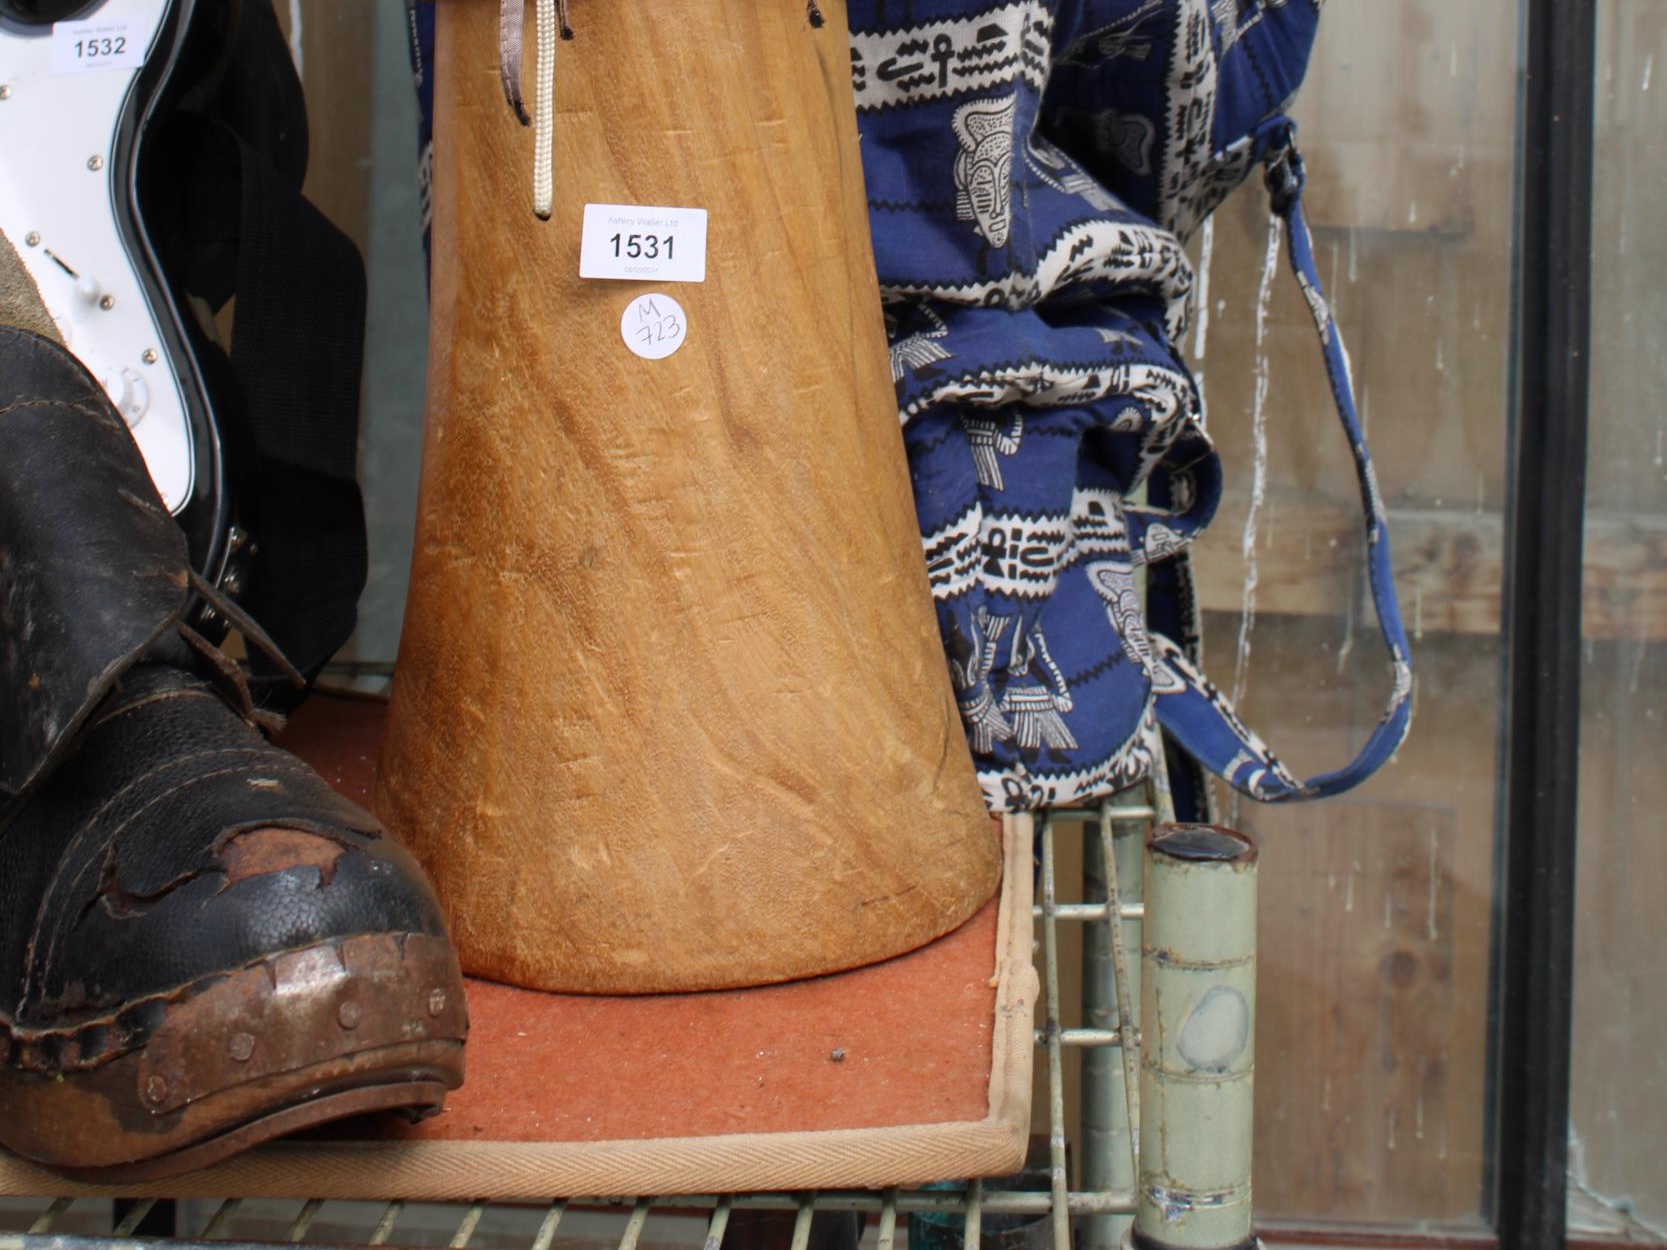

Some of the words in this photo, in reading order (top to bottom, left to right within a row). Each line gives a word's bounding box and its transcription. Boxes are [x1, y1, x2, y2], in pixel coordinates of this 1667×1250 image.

[74, 36, 127, 59] 1532
[610, 232, 674, 260] 1531
[636, 314, 681, 346] 723
